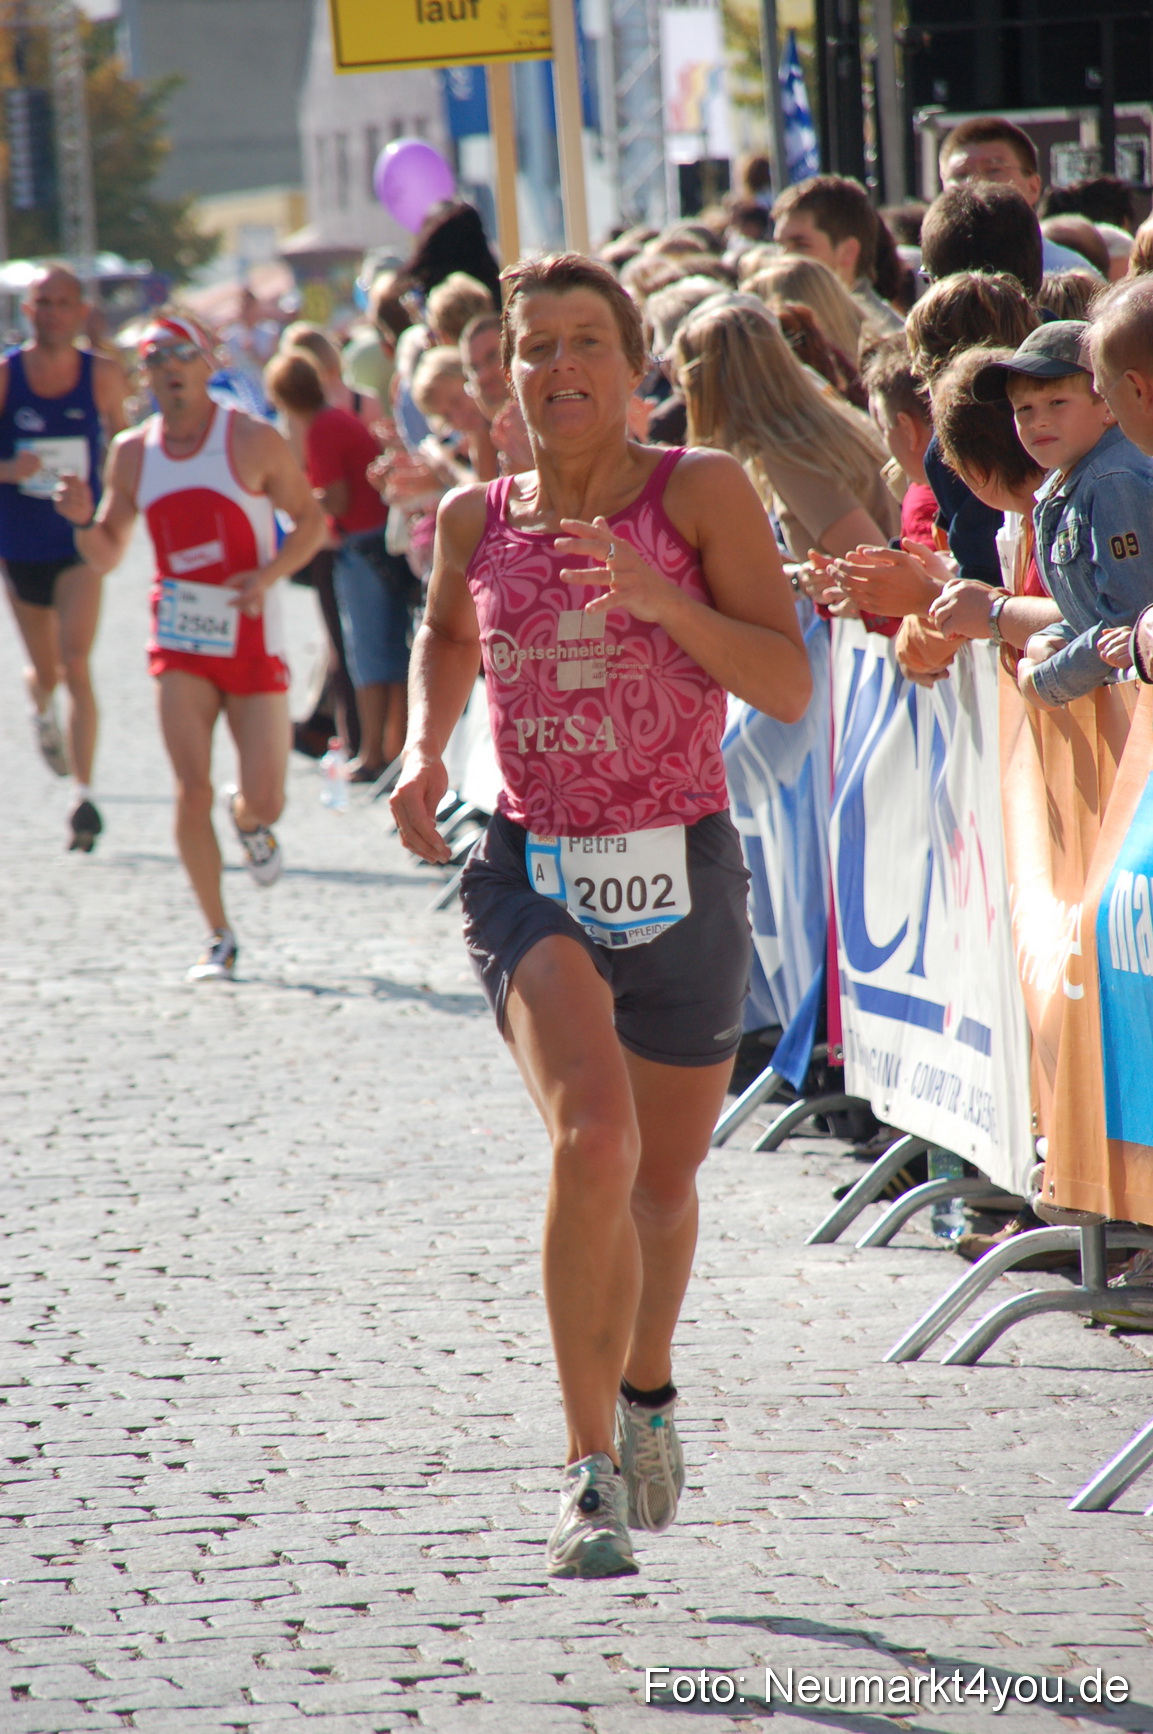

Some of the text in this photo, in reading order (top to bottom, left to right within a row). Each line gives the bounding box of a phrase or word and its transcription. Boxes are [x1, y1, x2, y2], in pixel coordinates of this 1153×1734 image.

[417, 0, 481, 24] lauf
[1110, 532, 1140, 560] 09
[492, 641, 625, 671] Bretschneider
[514, 715, 619, 754] PESA
[568, 836, 627, 854] Petra
[535, 863, 545, 882] A
[573, 873, 676, 914] 2002
